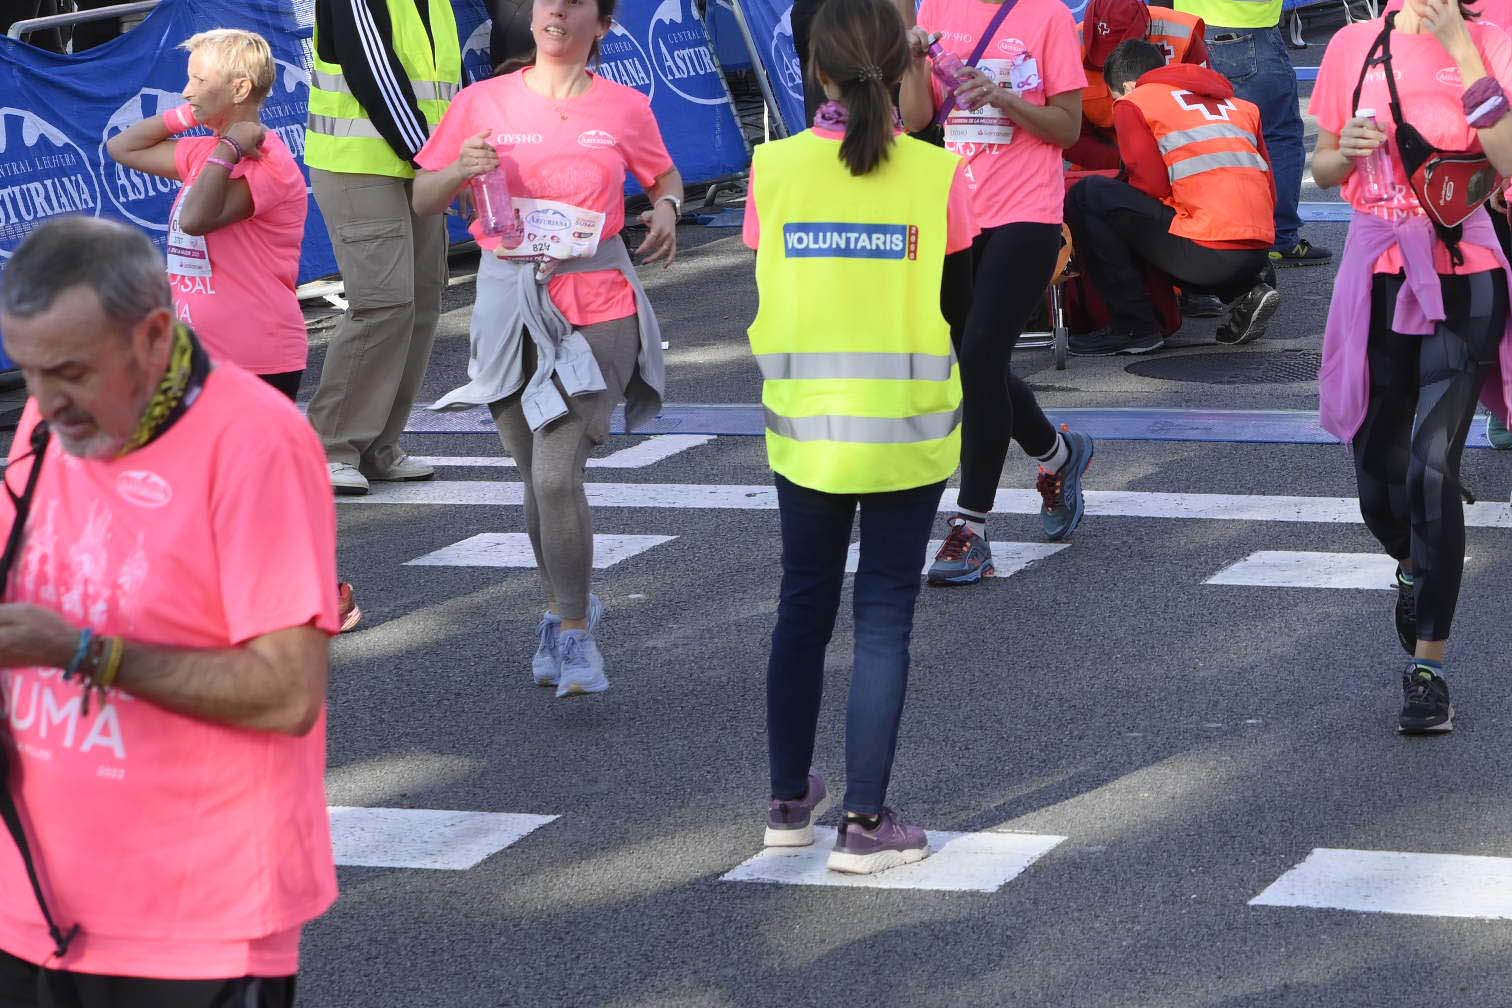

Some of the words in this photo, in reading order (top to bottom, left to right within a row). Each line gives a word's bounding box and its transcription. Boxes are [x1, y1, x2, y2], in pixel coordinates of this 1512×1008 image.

[0, 159, 33, 178] NTRAL
[37, 153, 78, 172] LECHERA
[785, 232, 904, 251] VOLUNTARIS
[10, 675, 127, 759] UMA
